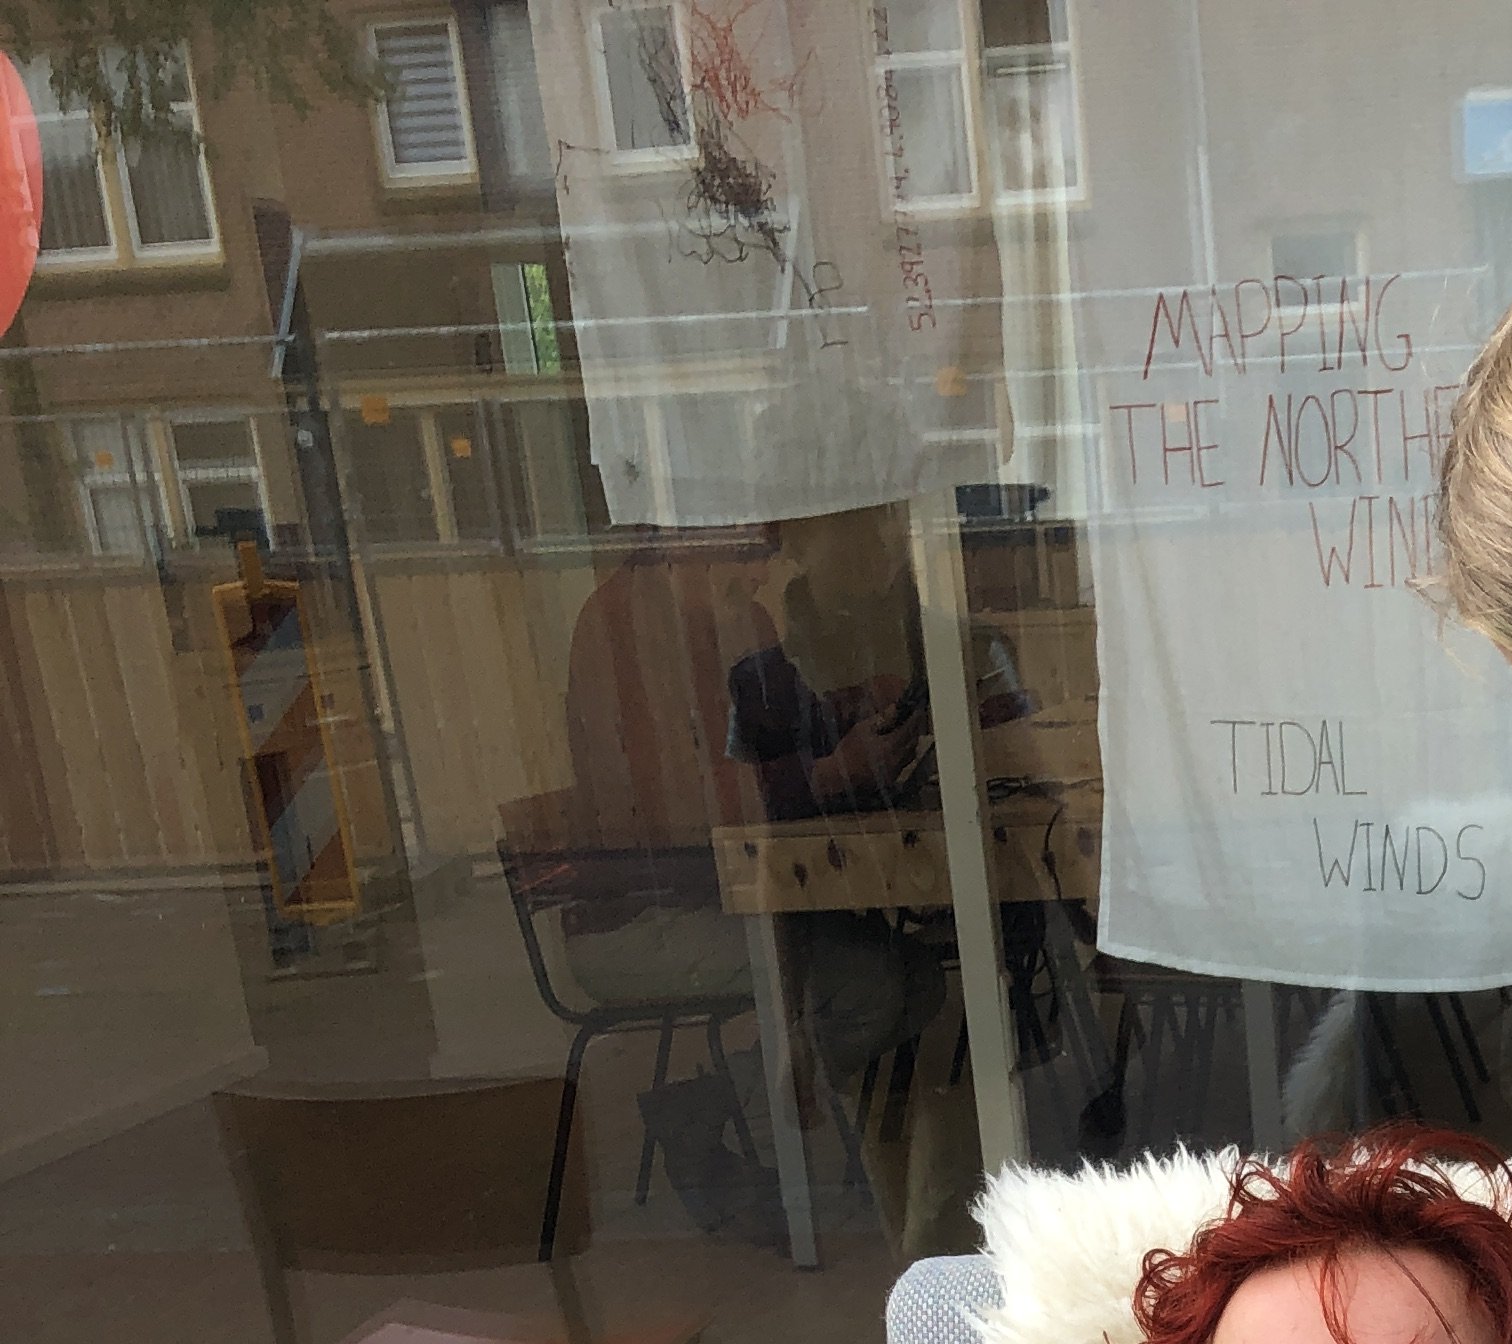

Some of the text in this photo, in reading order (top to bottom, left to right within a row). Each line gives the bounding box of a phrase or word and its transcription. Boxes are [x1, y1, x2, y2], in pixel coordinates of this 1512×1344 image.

[1143, 273, 1413, 381] MAPPING
[1110, 400, 1224, 489] THE
[1211, 718, 1367, 796] TIDAL
[1314, 817, 1487, 900] WINDS
